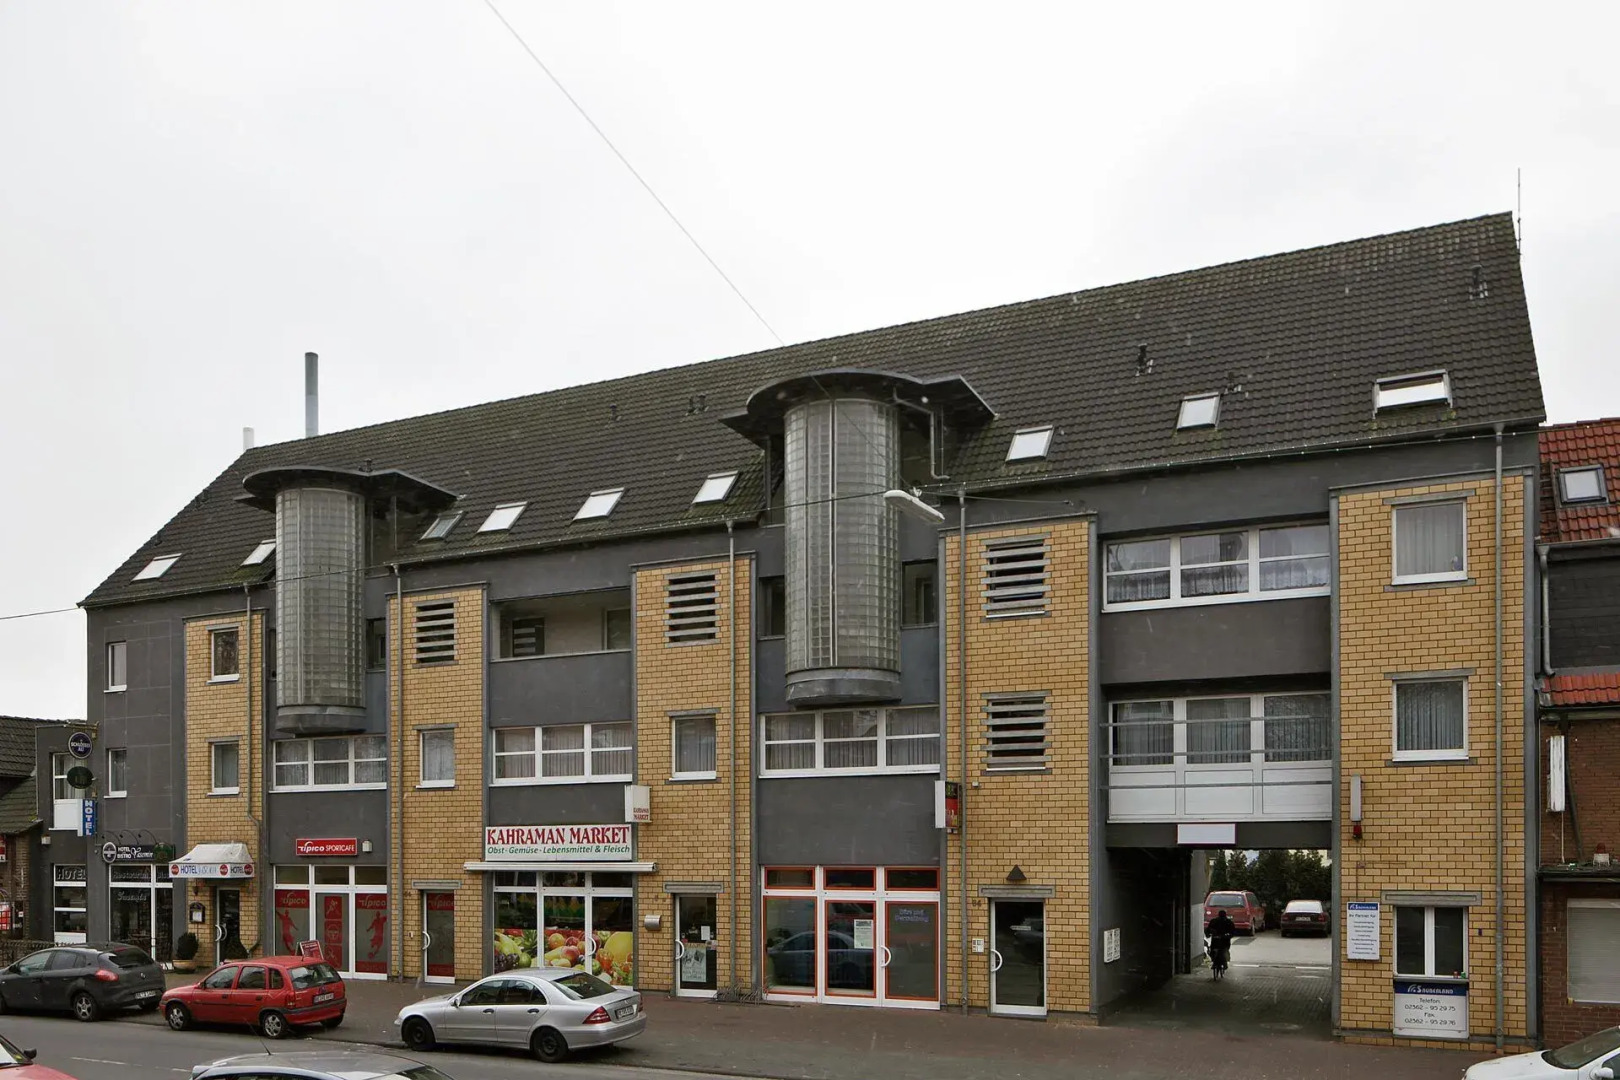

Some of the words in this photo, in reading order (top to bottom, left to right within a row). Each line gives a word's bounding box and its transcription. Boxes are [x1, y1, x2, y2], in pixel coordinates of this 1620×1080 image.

[84, 800, 93, 836] HOTEL
[487, 828, 565, 844] KAHRAMAN
[570, 826, 630, 844] MARKET
[543, 846, 593, 854] Lebensmittel
[57, 866, 86, 880] HOTEL
[180, 866, 198, 874] HOTEL
